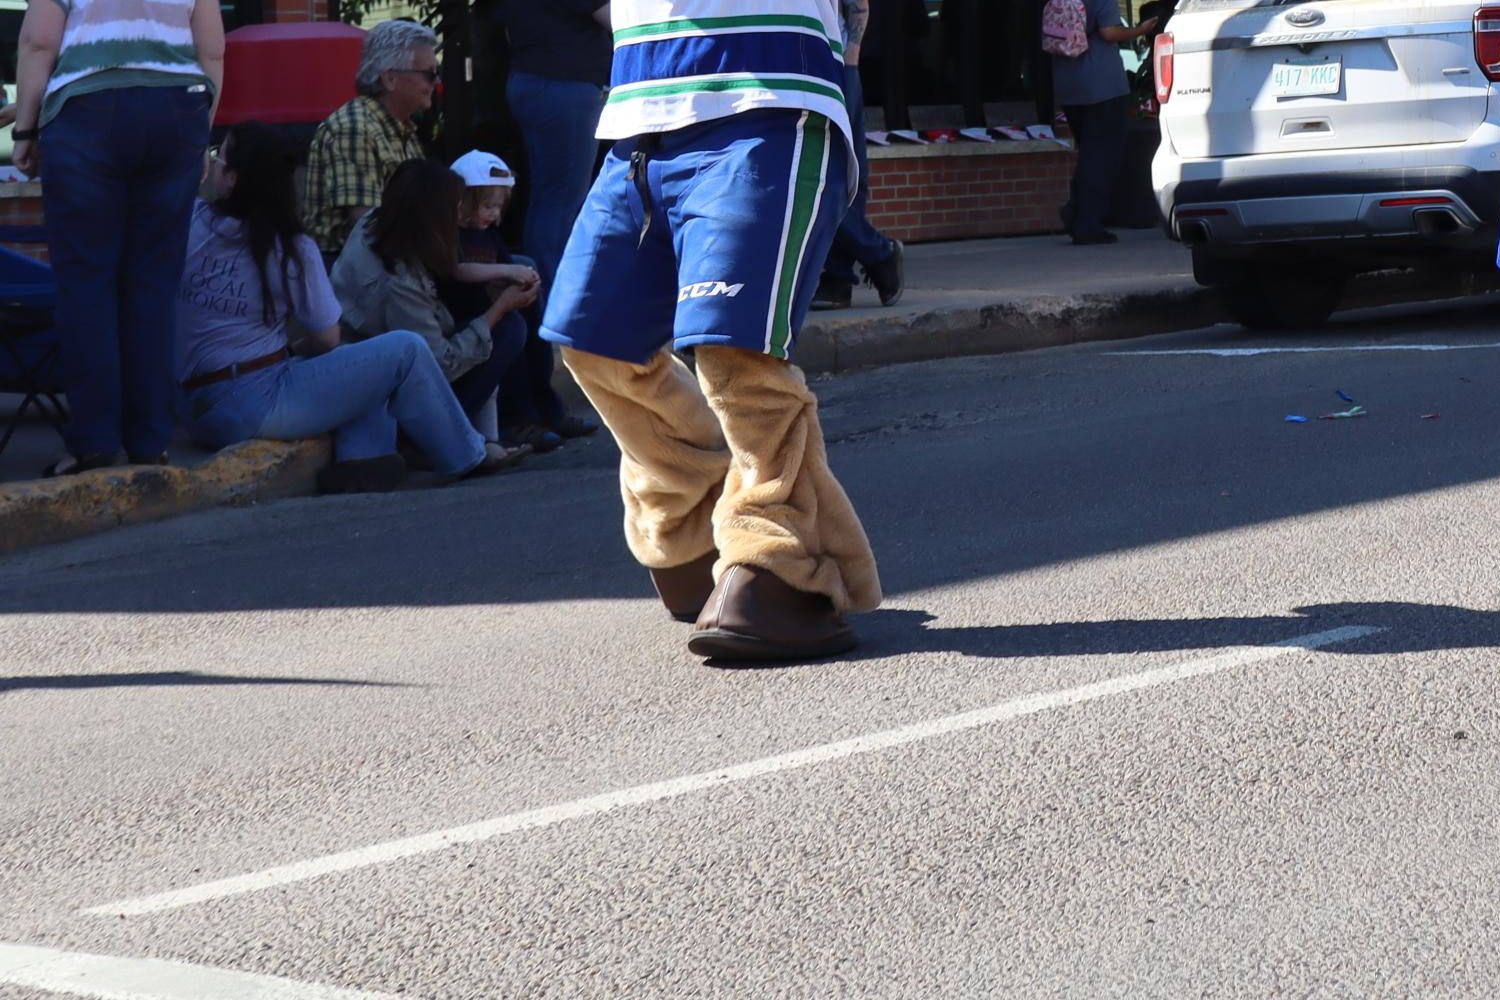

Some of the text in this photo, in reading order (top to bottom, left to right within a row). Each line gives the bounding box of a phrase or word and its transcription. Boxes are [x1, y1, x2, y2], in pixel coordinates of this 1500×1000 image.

[1274, 68, 1302, 87] 417
[184, 272, 248, 299] OCAL
[677, 280, 745, 304] CCM
